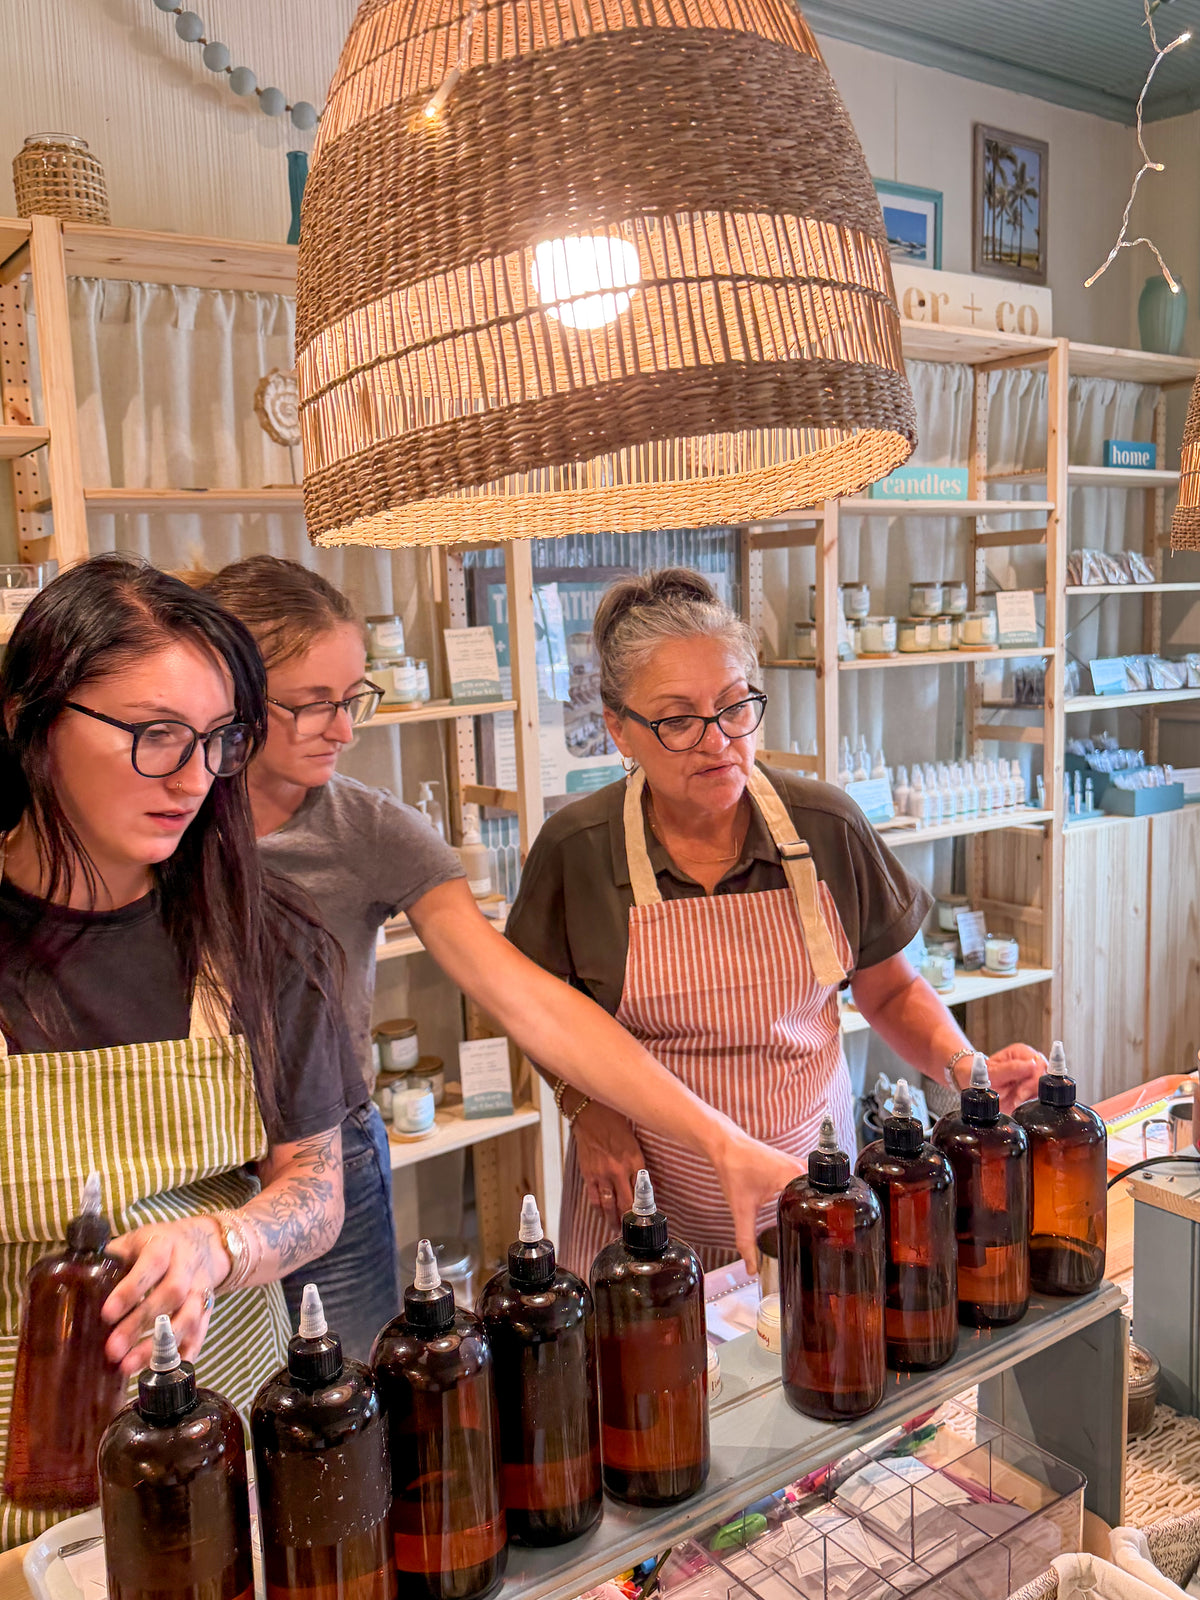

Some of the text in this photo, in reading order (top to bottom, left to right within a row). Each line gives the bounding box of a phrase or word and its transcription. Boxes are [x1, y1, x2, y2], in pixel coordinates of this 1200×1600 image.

[995, 300, 1039, 336] co
[1112, 444, 1150, 467] home
[882, 473, 962, 495] candles
